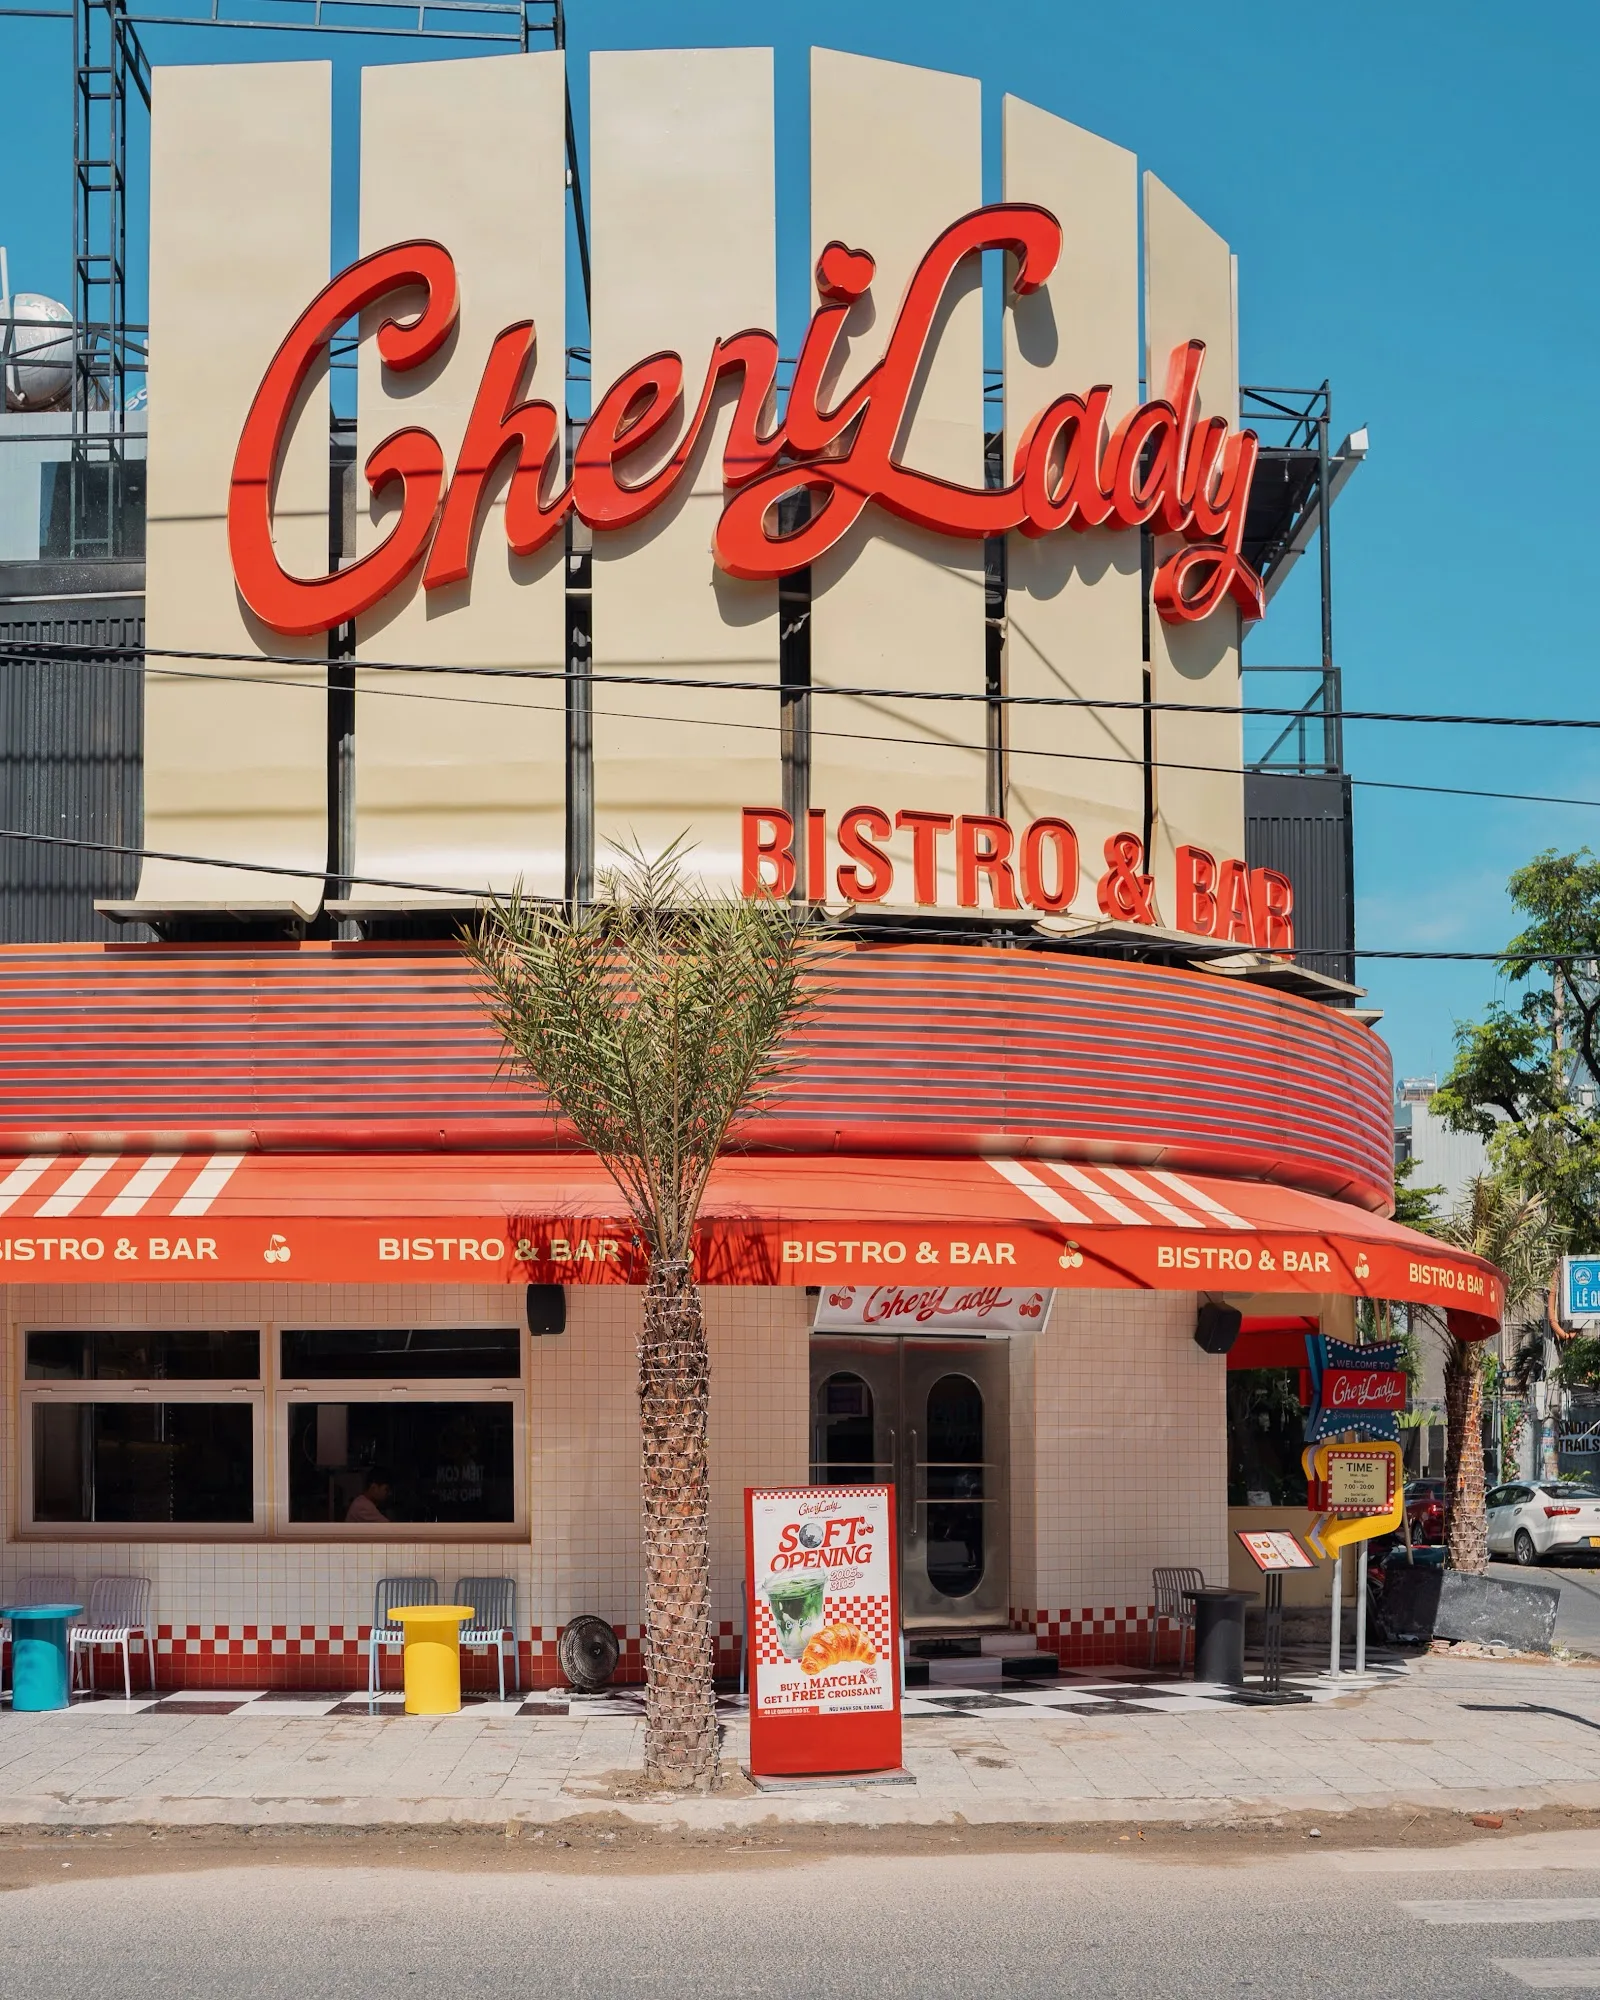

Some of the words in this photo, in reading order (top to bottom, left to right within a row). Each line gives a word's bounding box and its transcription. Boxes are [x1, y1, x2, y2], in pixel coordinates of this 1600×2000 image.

[741, 805, 1079, 911] BISTRO
[1097, 831, 1157, 925] &
[1176, 845, 1295, 960] BAR
[113, 1238, 139, 1260] &
[149, 1238, 219, 1260] BAR
[379, 1238, 505, 1261] BISTRO
[514, 1238, 540, 1261] &
[550, 1239, 621, 1261] BAR
[782, 1241, 906, 1264] BISTRO
[915, 1241, 940, 1264] &
[950, 1242, 1017, 1264] BAR
[1157, 1246, 1252, 1270] BISTRO
[1258, 1250, 1276, 1271] &
[1283, 1250, 1331, 1273] BAR
[1409, 1263, 1454, 1288] BISTRO
[1456, 1272, 1465, 1291] &
[1467, 1275, 1484, 1296] BAR
[1576, 1287, 1588, 1307] LÊ
[1336, 1360, 1378, 1368] WELCOME
[1559, 1438, 1600, 1452] TRAILS
[1346, 1463, 1372, 1472] TIME
[770, 1544, 872, 1572] OPENING
[780, 1683, 800, 1691] BUY
[803, 1682, 807, 1690] 1
[809, 1674, 867, 1689] MATCHA
[764, 1696, 783, 1704] GET
[792, 1689, 825, 1701] FREE
[828, 1687, 882, 1698] CROISSANT
